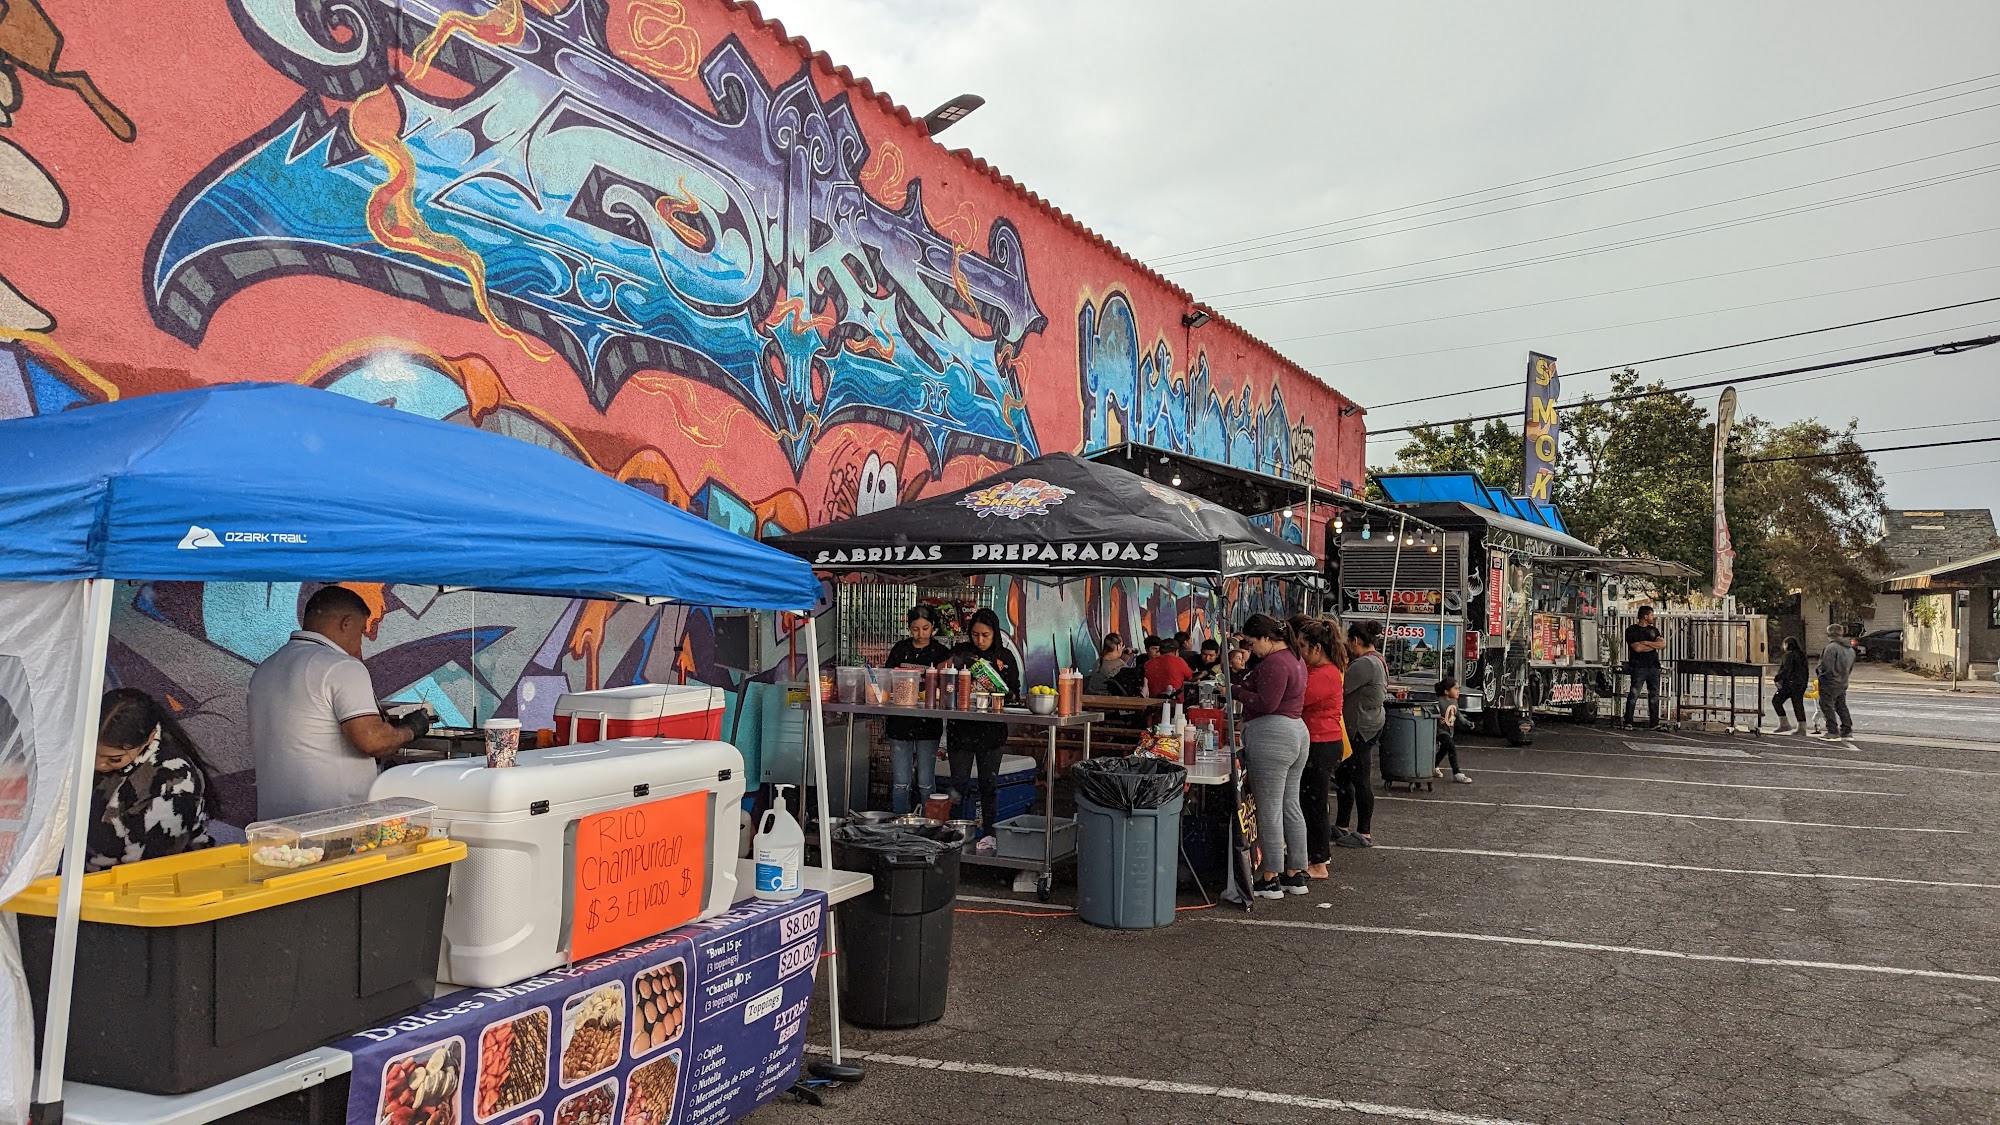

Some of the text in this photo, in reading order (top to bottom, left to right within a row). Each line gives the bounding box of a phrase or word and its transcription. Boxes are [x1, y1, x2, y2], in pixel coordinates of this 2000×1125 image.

[225, 532, 307, 544] OZARK TRAIL
[815, 542, 1159, 564] SABRITAS PREPARADAS
[1358, 590, 1385, 604] EL
[605, 895, 620, 923] 3
[786, 910, 816, 940] $8.00
[726, 941, 734, 952] 15
[735, 939, 742, 952] pc
[781, 941, 815, 976] $20.00
[745, 971, 752, 985] pc
[352, 999, 485, 1042] Dulces
[473, 976, 564, 1002] Mini
[748, 994, 780, 1017] Toppings
[774, 995, 809, 1031] EXTRAS
[704, 1044, 723, 1060] Cajeta
[701, 1057, 726, 1075] Lechera
[698, 1072, 721, 1091] Nutella
[722, 1086, 741, 1101] sugar
